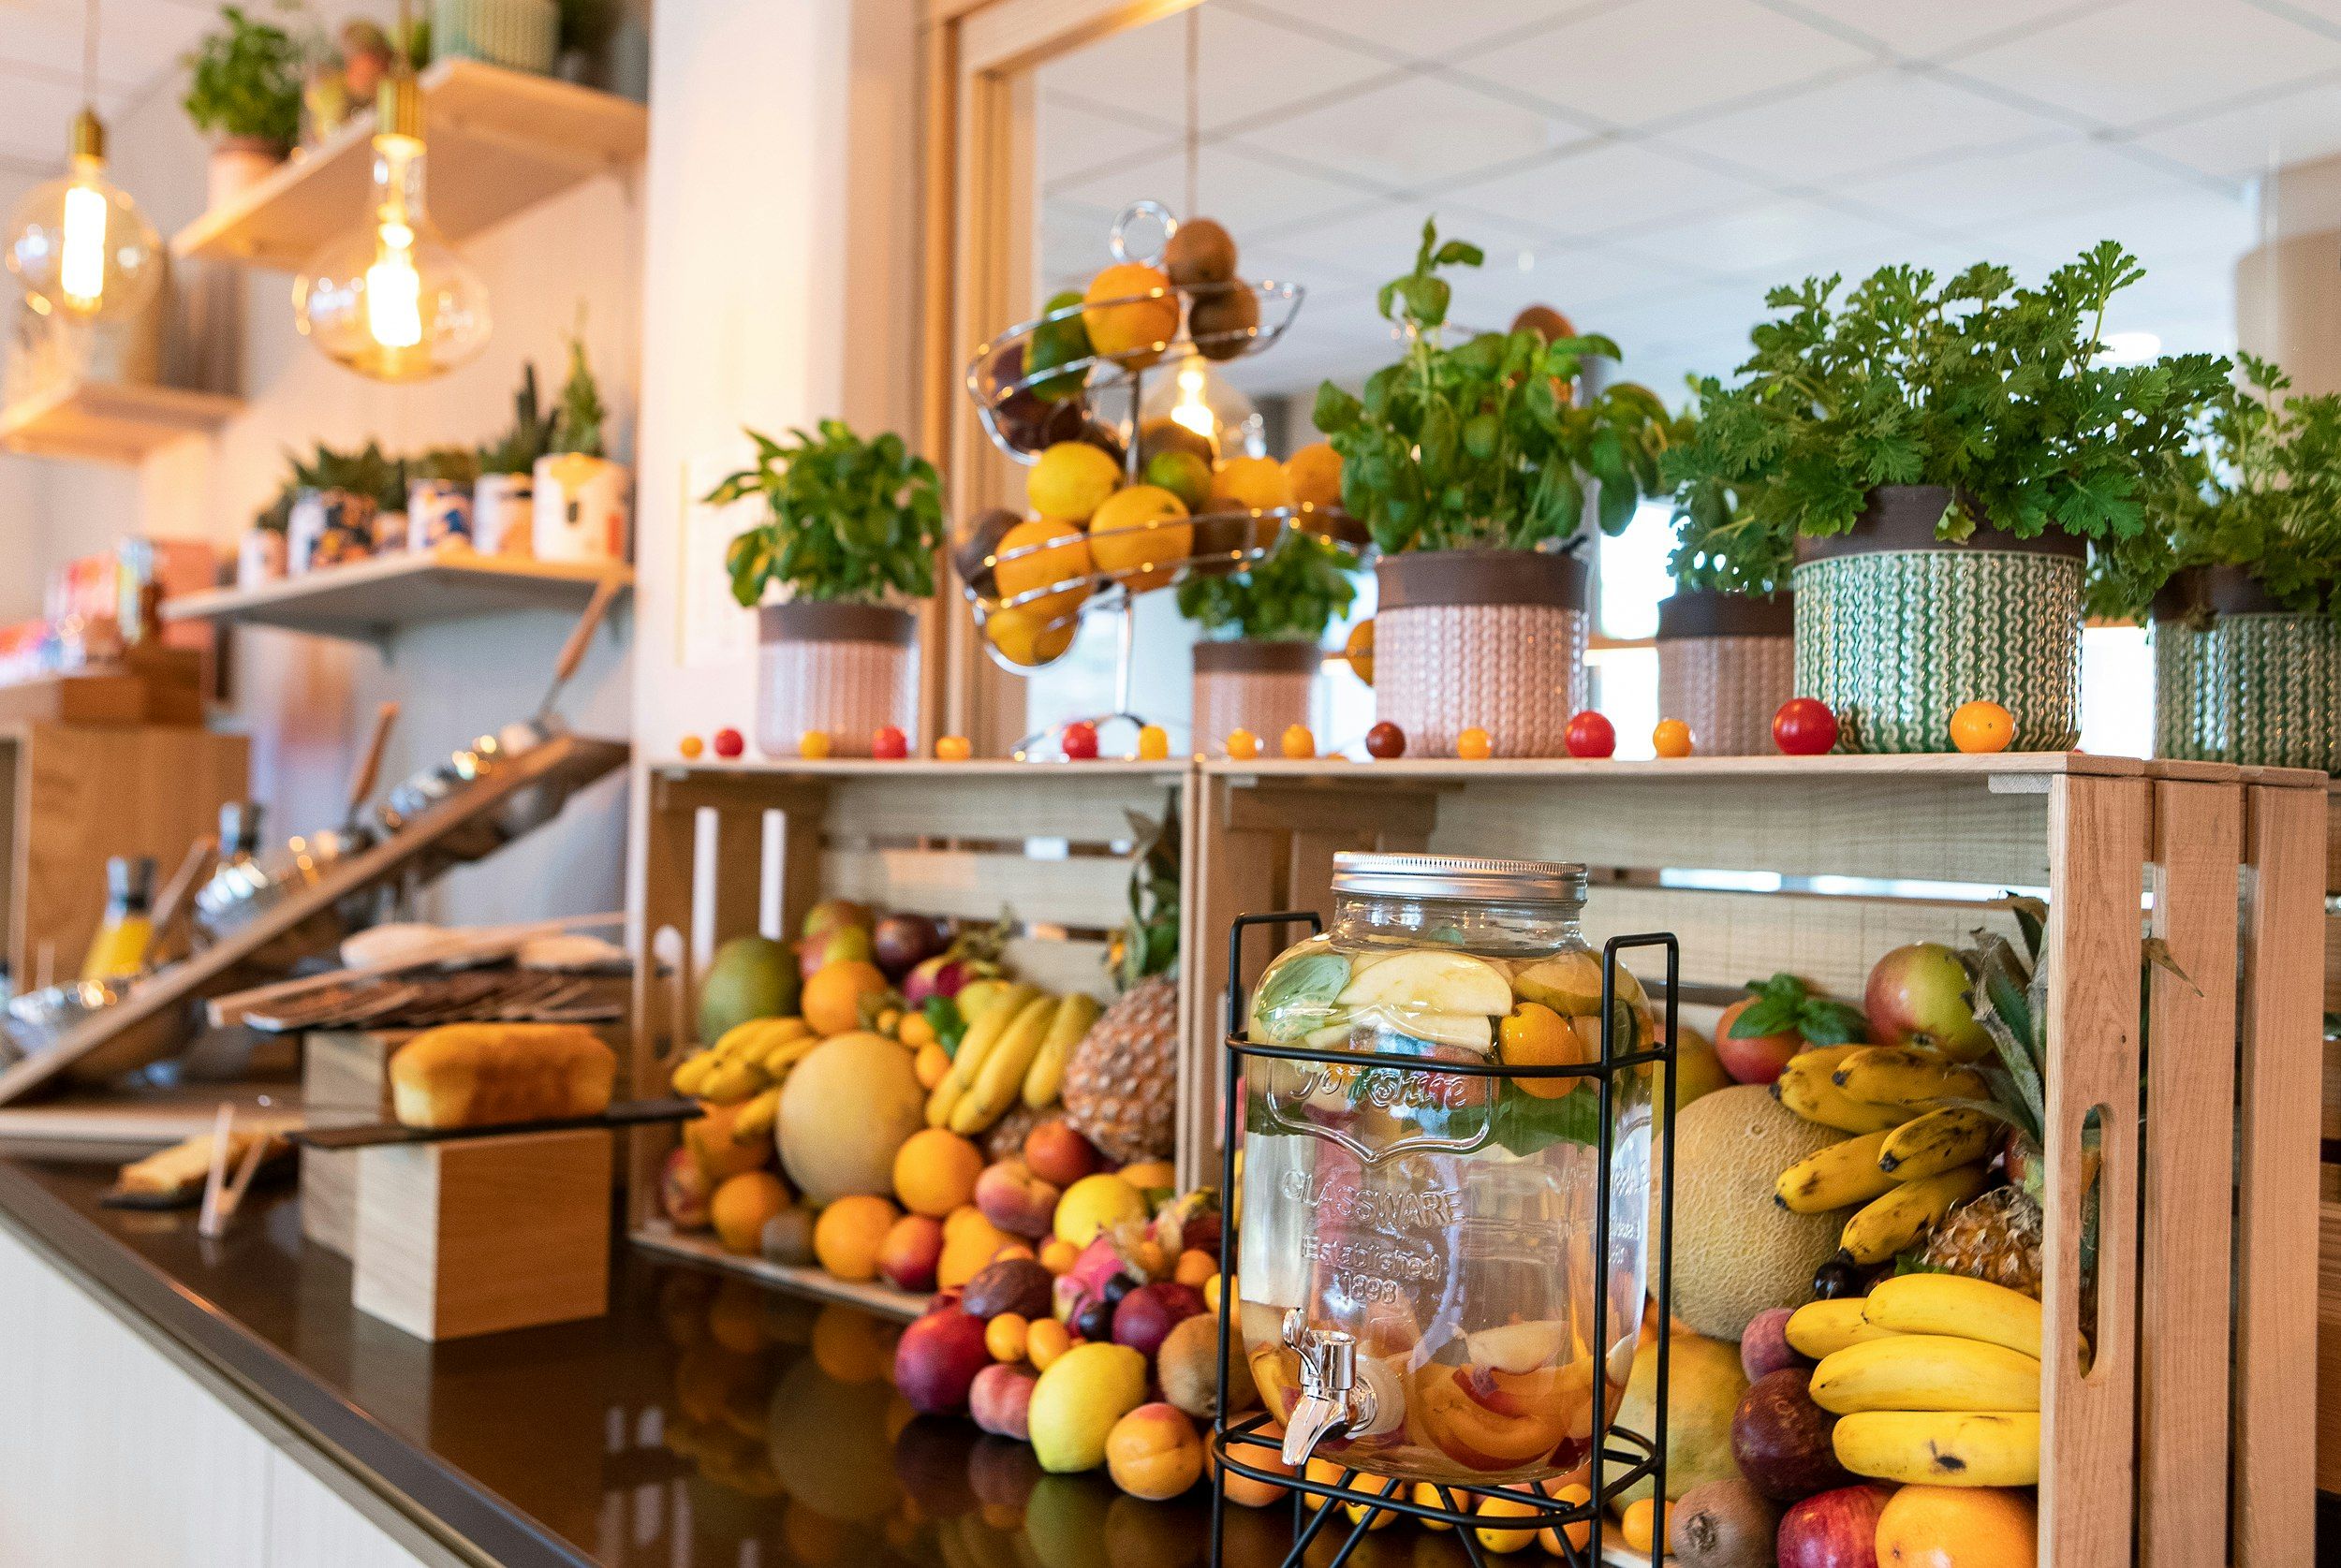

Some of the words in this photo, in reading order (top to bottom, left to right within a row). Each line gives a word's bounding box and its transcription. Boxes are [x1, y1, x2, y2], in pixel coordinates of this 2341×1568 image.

[1282, 1170, 1465, 1229] GLASSWARE
[1303, 1234, 1441, 1282] Established
[1339, 1270, 1399, 1304] 1898
